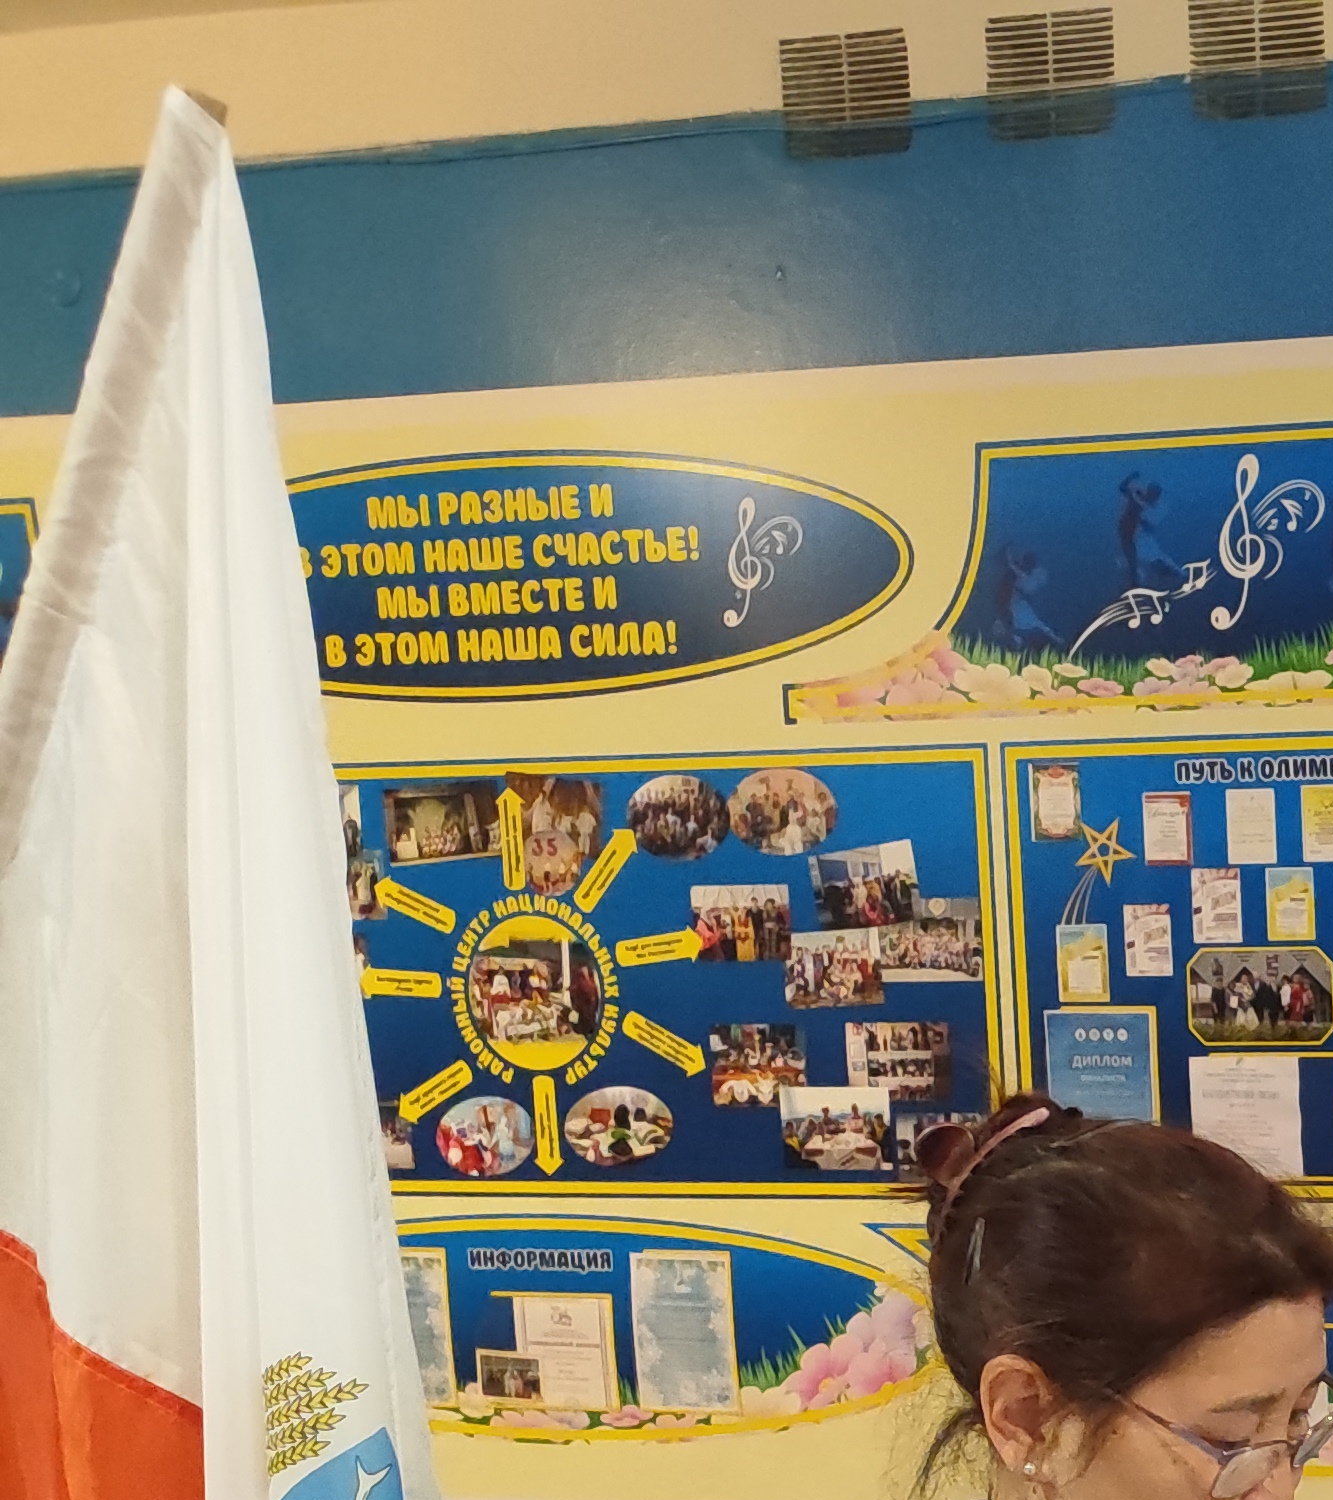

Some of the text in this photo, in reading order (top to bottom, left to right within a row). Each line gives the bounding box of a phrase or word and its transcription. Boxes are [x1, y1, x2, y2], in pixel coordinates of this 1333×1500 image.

[366, 483, 614, 530] МЫ РАЗНЫЕ И
[320, 540, 416, 578] ЭТОМ
[422, 535, 524, 574] НАШЕ
[533, 526, 700, 568] СЧАСТЬЕ!
[376, 576, 618, 620] МЫ ВМЕСТЕ И
[324, 620, 677, 668] В ЭТОМ НАША СИЛА!
[1176, 759, 1234, 782] ПУТЬ
[1239, 759, 1254, 780] К
[452, 910, 491, 973] ЦЕНТР
[493, 893, 620, 998] НАЦИОНАЛЬНЫХ
[447, 976, 515, 1085] РАЙОННЫЙ
[565, 1003, 620, 1086] КУЛЬТУР
[1072, 1054, 1133, 1069] ДИПЛОМ
[468, 1249, 613, 1273] ИНФОРМАЦИЯ
